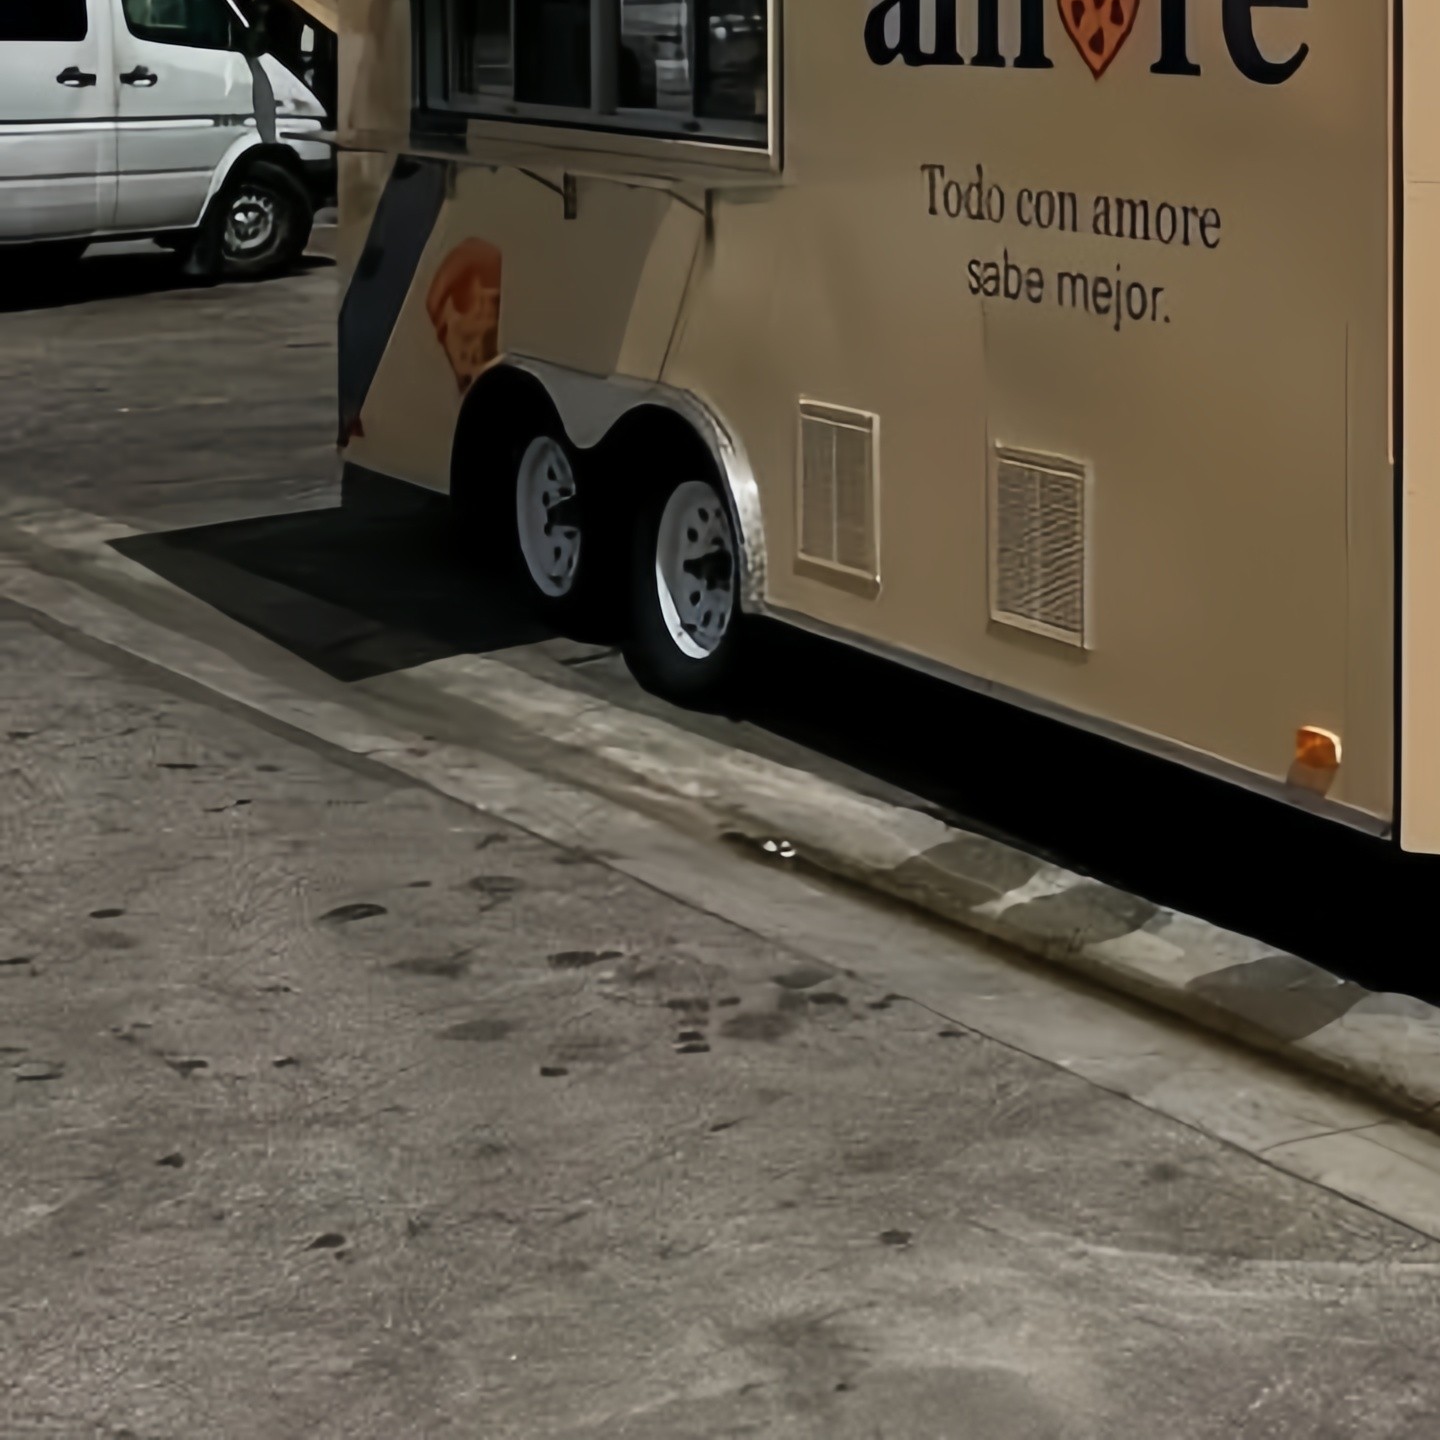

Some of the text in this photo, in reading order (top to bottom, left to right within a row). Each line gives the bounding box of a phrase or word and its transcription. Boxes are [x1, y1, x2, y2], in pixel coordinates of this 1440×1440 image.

[921, 164, 1222, 249] Todo con amore
[967, 249, 1172, 331] sabe mejor.
